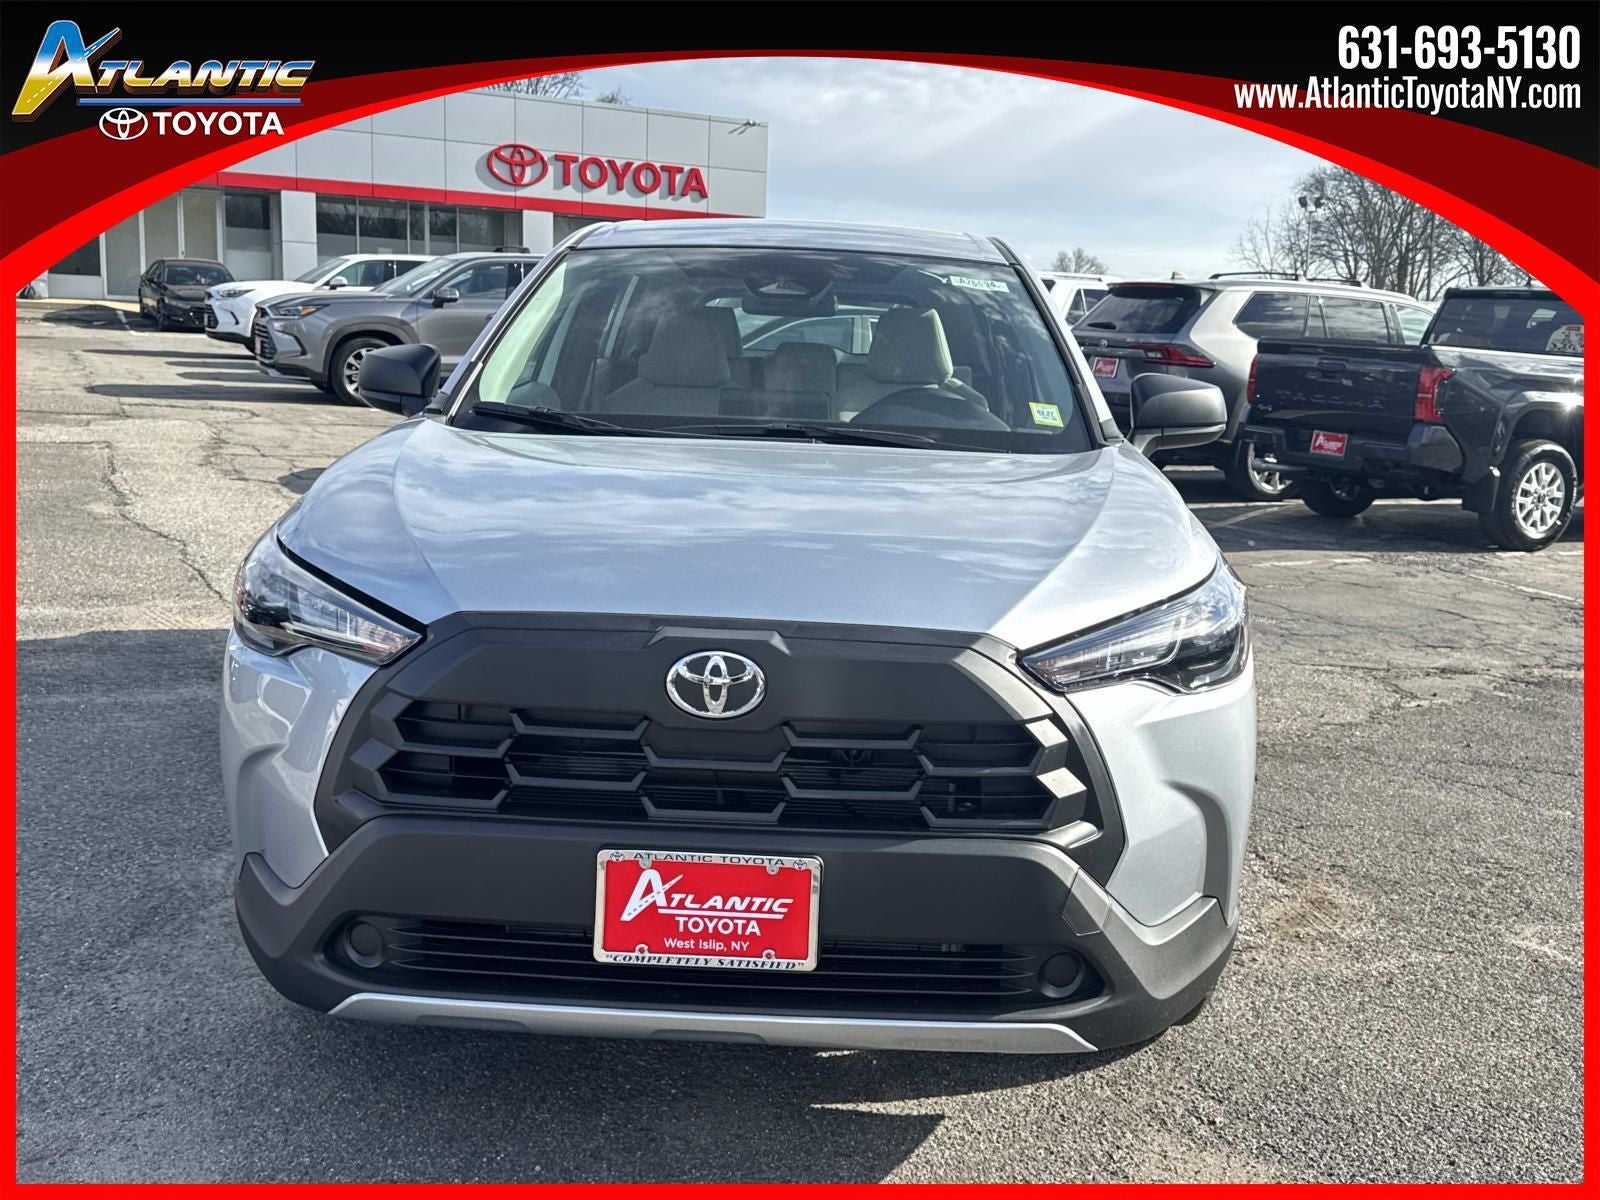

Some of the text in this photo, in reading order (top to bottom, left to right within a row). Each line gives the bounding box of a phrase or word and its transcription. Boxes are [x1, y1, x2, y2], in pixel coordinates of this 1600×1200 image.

[554, 154, 708, 198] TOYOTA
[633, 853, 785, 866] ATLANTIC TOYOTA
[620, 869, 794, 921] ATLANTIC
[675, 916, 761, 937] TOYOTA
[664, 938, 750, 952] West Islip, NY
